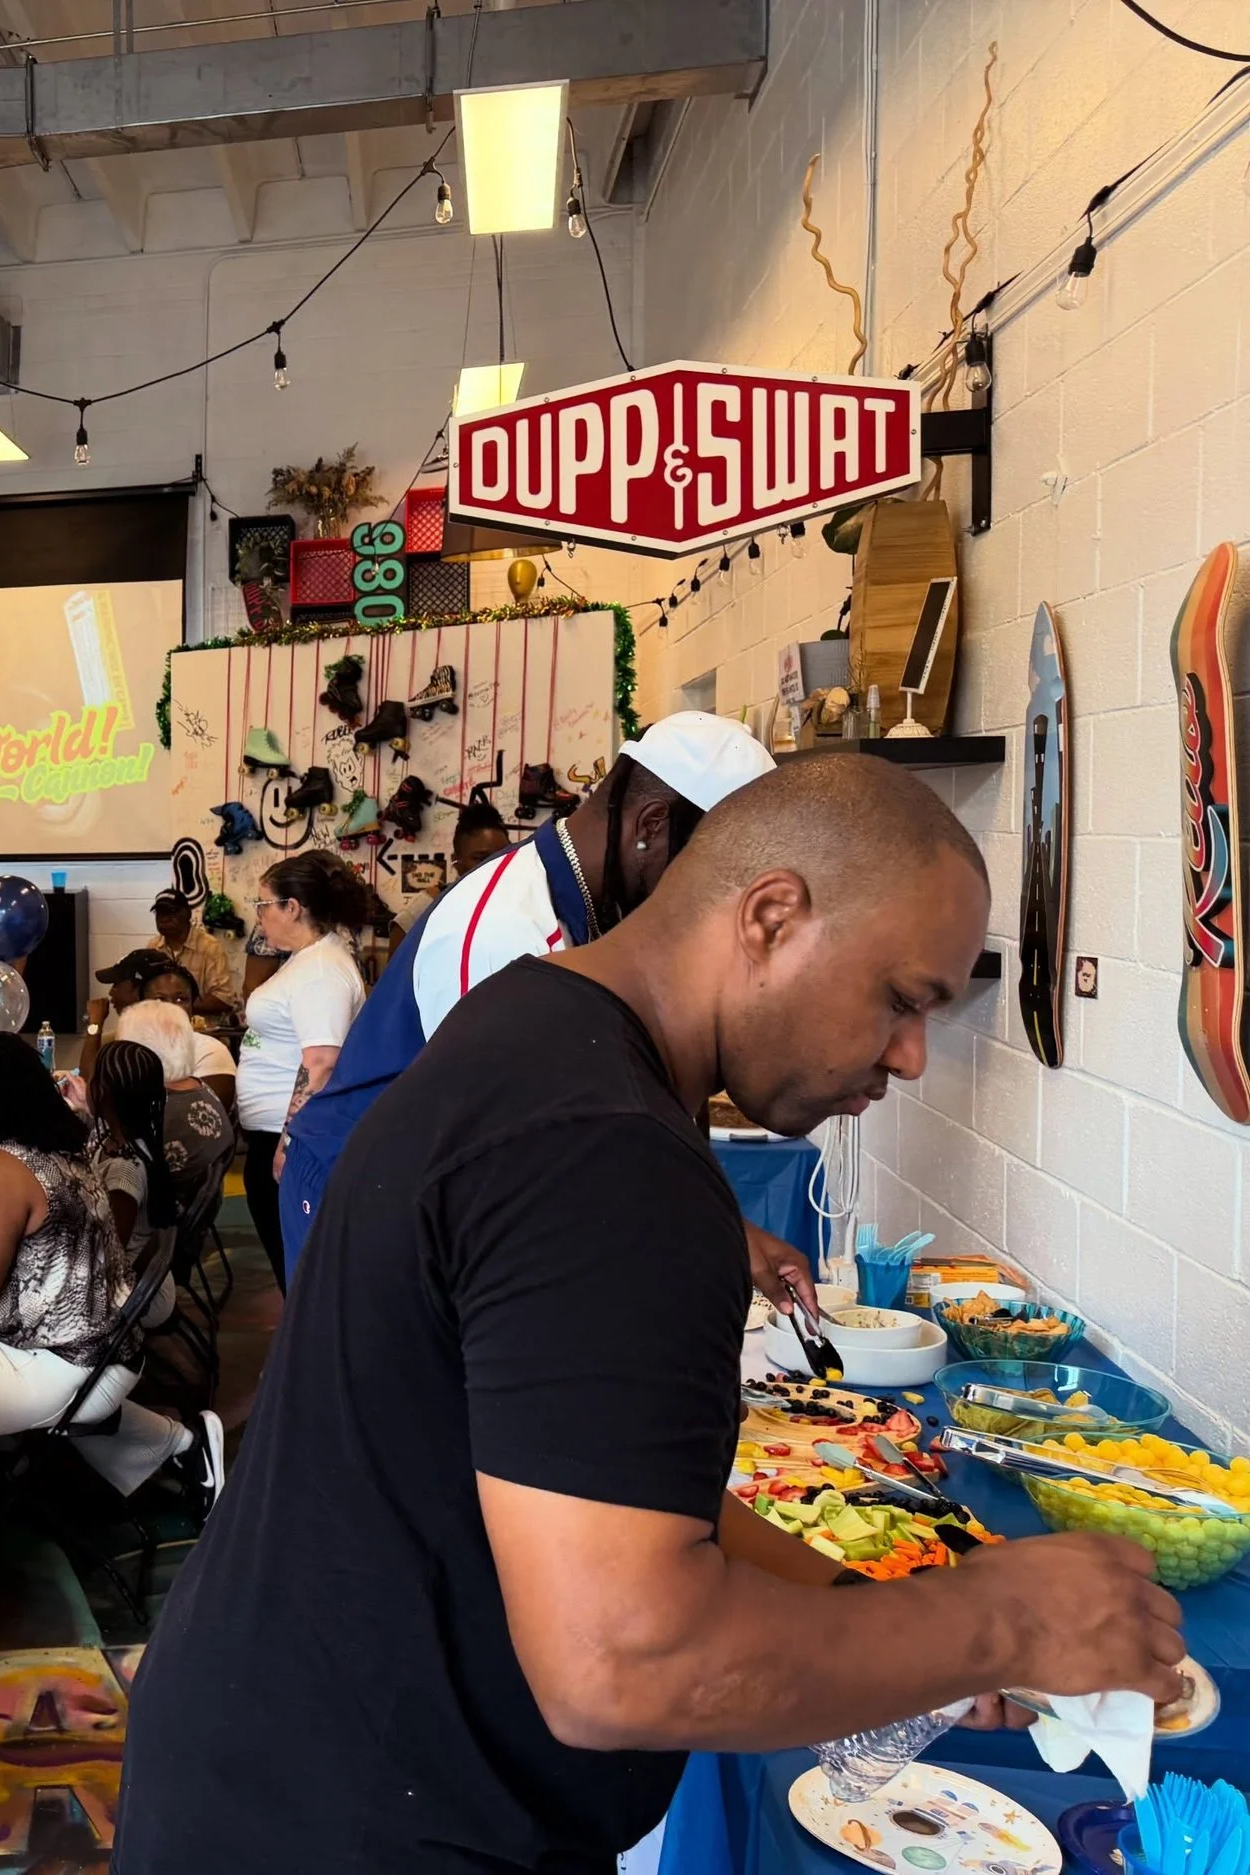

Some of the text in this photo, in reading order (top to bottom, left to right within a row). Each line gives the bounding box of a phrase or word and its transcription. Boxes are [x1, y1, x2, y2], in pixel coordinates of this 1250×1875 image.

[471, 388, 659, 524] DUPP
[697, 382, 896, 526] SWAT
[21, 743, 154, 803] Cannon!
